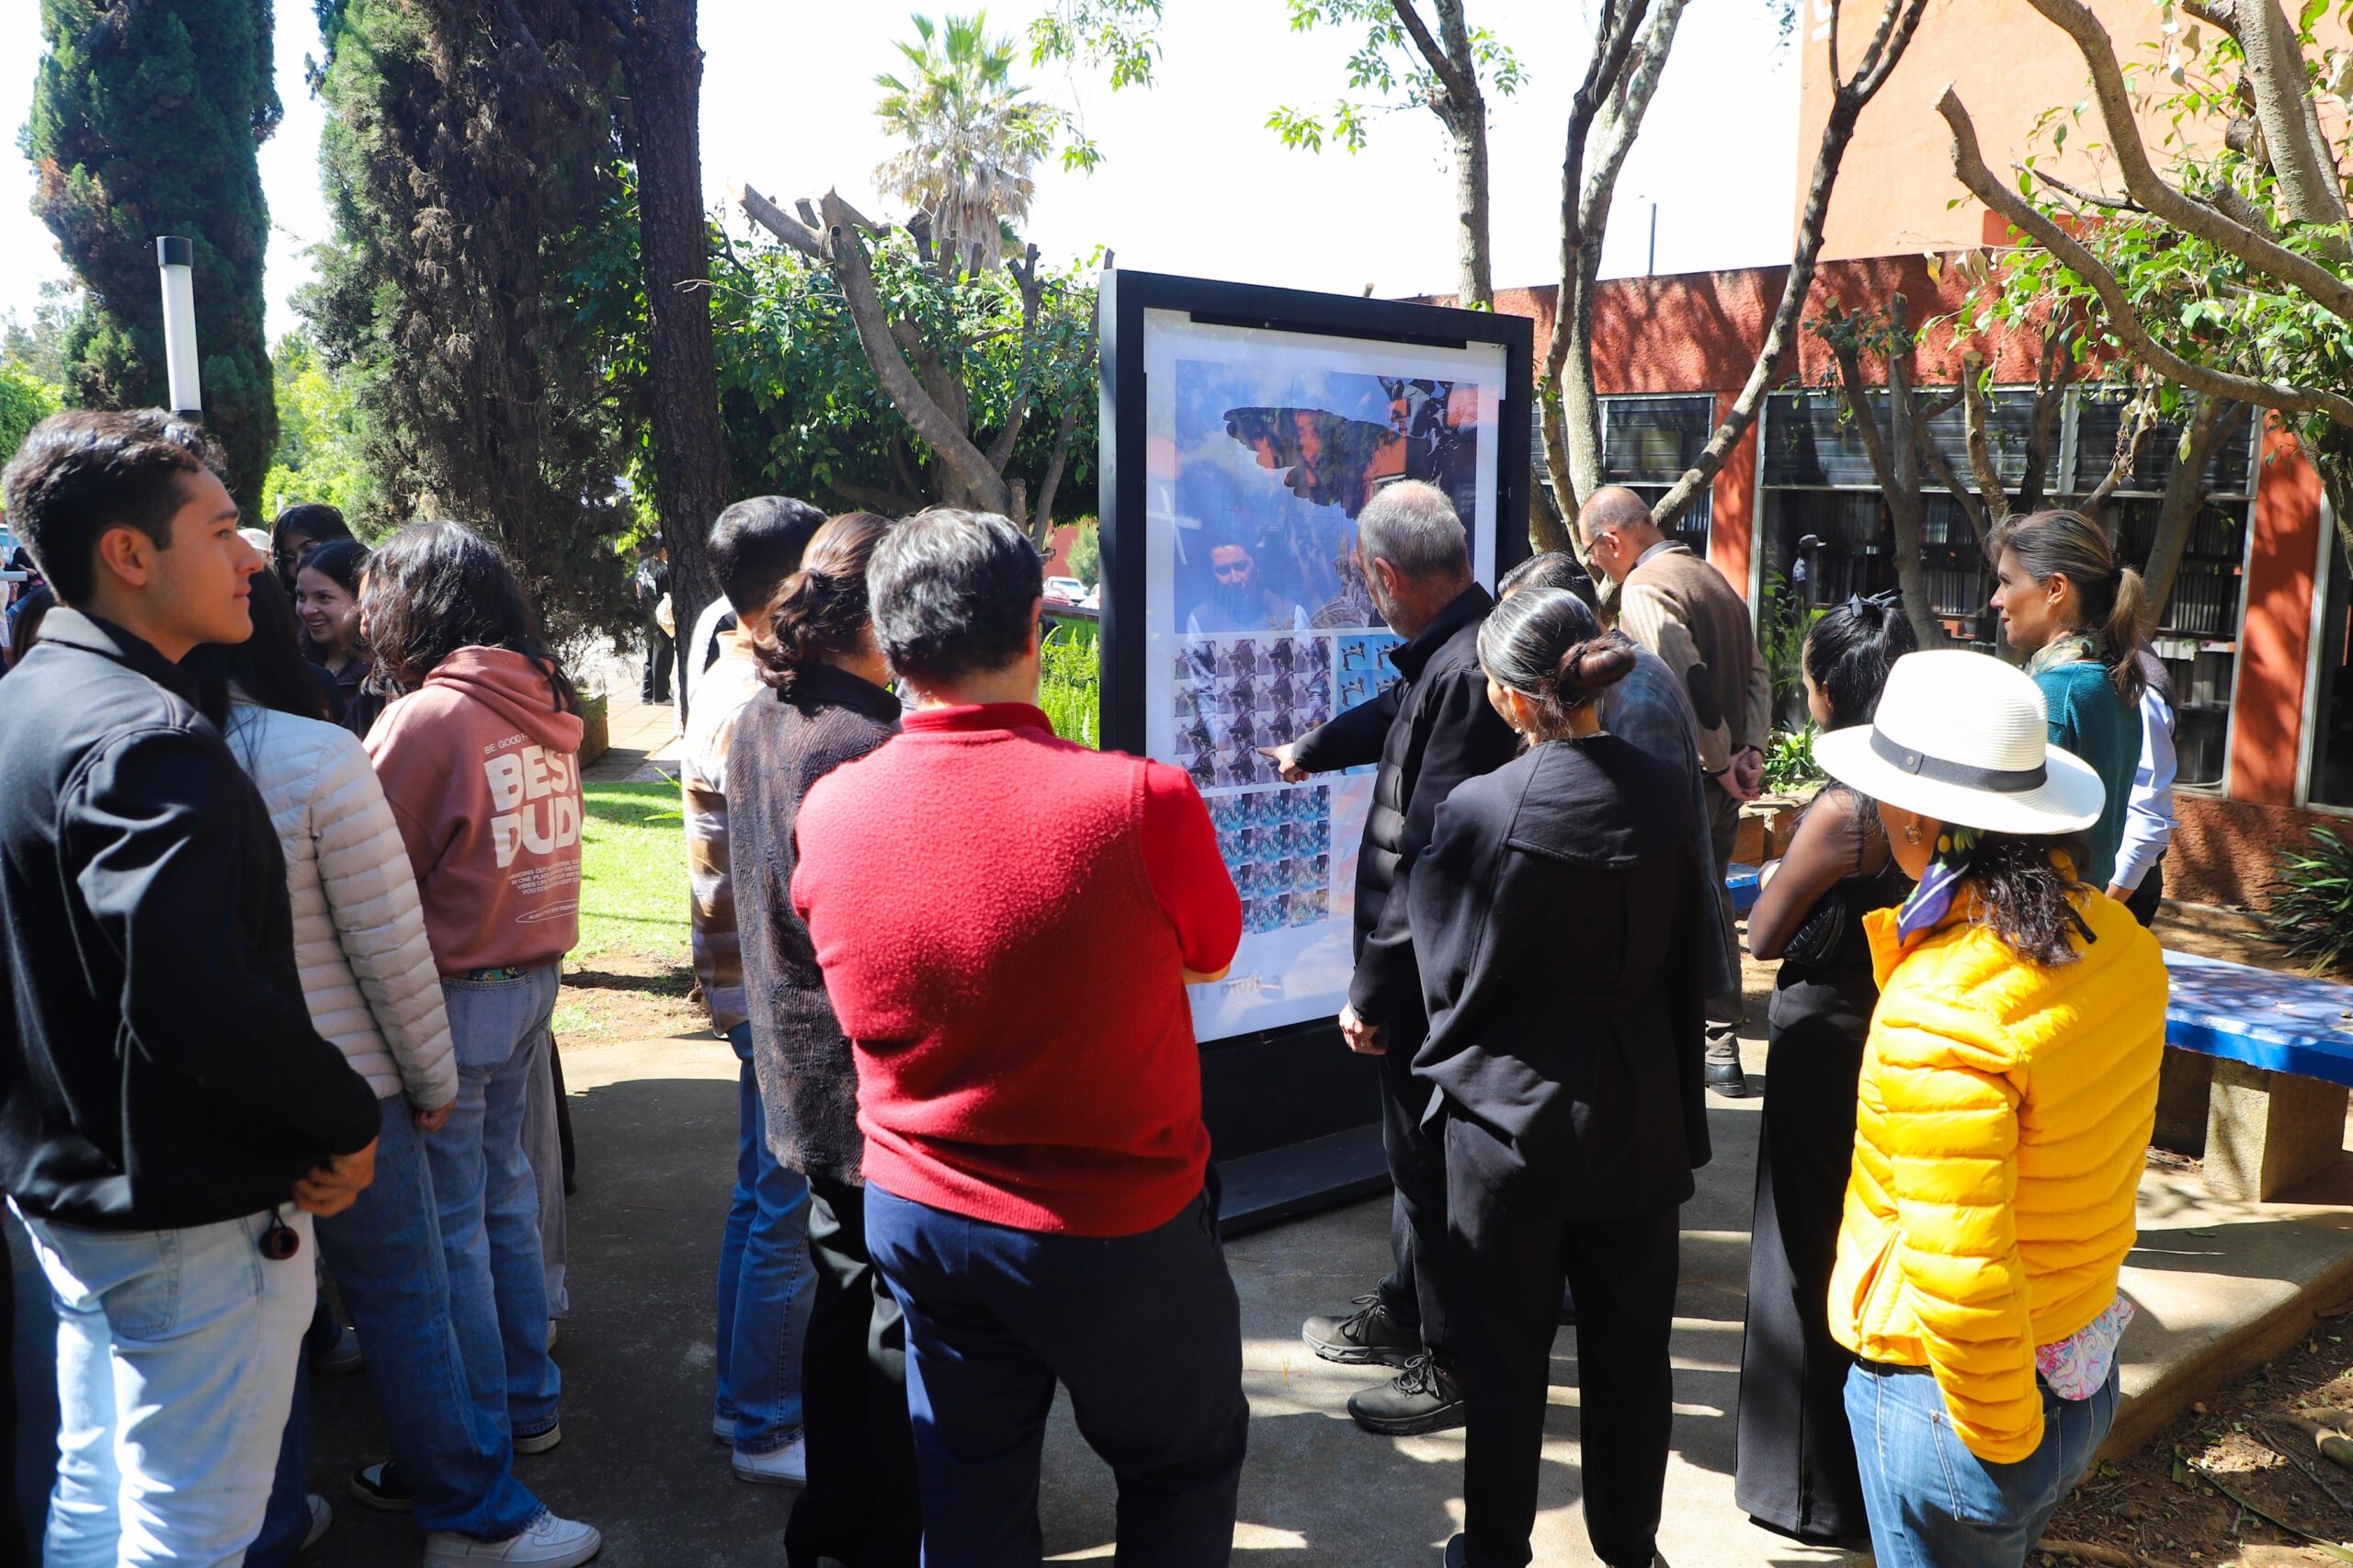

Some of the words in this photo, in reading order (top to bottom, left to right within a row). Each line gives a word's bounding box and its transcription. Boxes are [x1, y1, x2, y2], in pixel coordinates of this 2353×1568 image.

[484, 743, 497, 755] BE
[497, 734, 522, 749] GOOD
[491, 794, 582, 869] DUD
